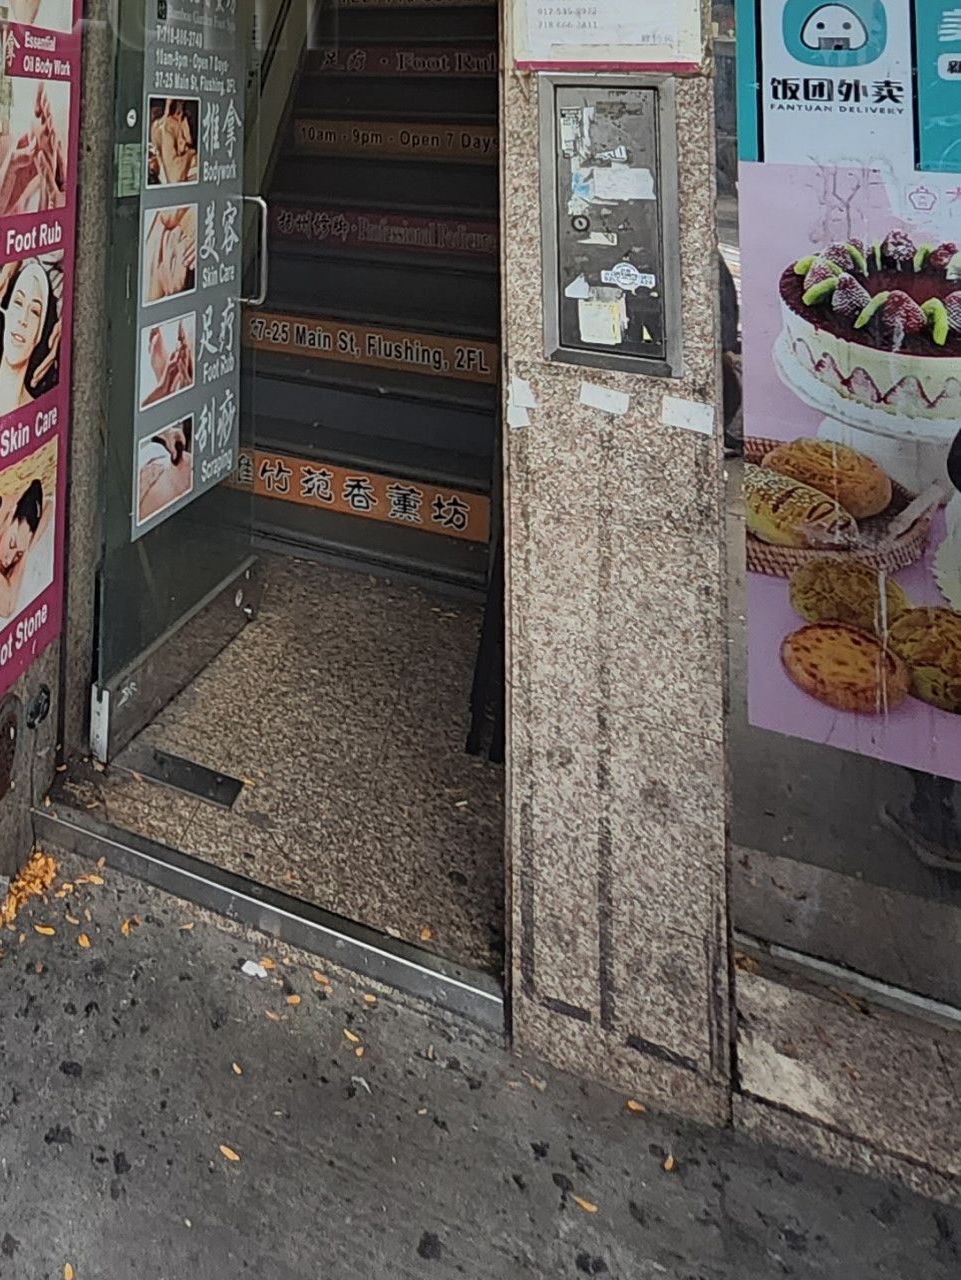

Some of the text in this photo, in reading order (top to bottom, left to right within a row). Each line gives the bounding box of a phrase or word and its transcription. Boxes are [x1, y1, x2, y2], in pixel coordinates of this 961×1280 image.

[24, 32, 56, 54] Essential
[23, 55, 71, 78] Oil Body Work
[396, 51, 450, 71] Foot
[770, 77, 905, 104] 饭团外卖
[769, 103, 905, 116] FANTUAN DELIVERY
[202, 98, 243, 158] 推拿
[400, 129, 440, 149] Open
[446, 131, 454, 147] 7
[203, 158, 237, 186] Bodywork
[6, 220, 63, 256] Foot Rub
[199, 200, 239, 263] 美容
[358, 215, 437, 248] Professional
[202, 262, 235, 289] Skin Care
[294, 324, 332, 351] Main
[337, 329, 361, 357] St,
[366, 334, 448, 370] Flushing,
[455, 348, 489, 373] 2FL
[203, 351, 235, 385] Foot Rub
[0, 406, 58, 460] Skin Care
[201, 449, 233, 483] Scraping
[15, 603, 48, 652] Stone
